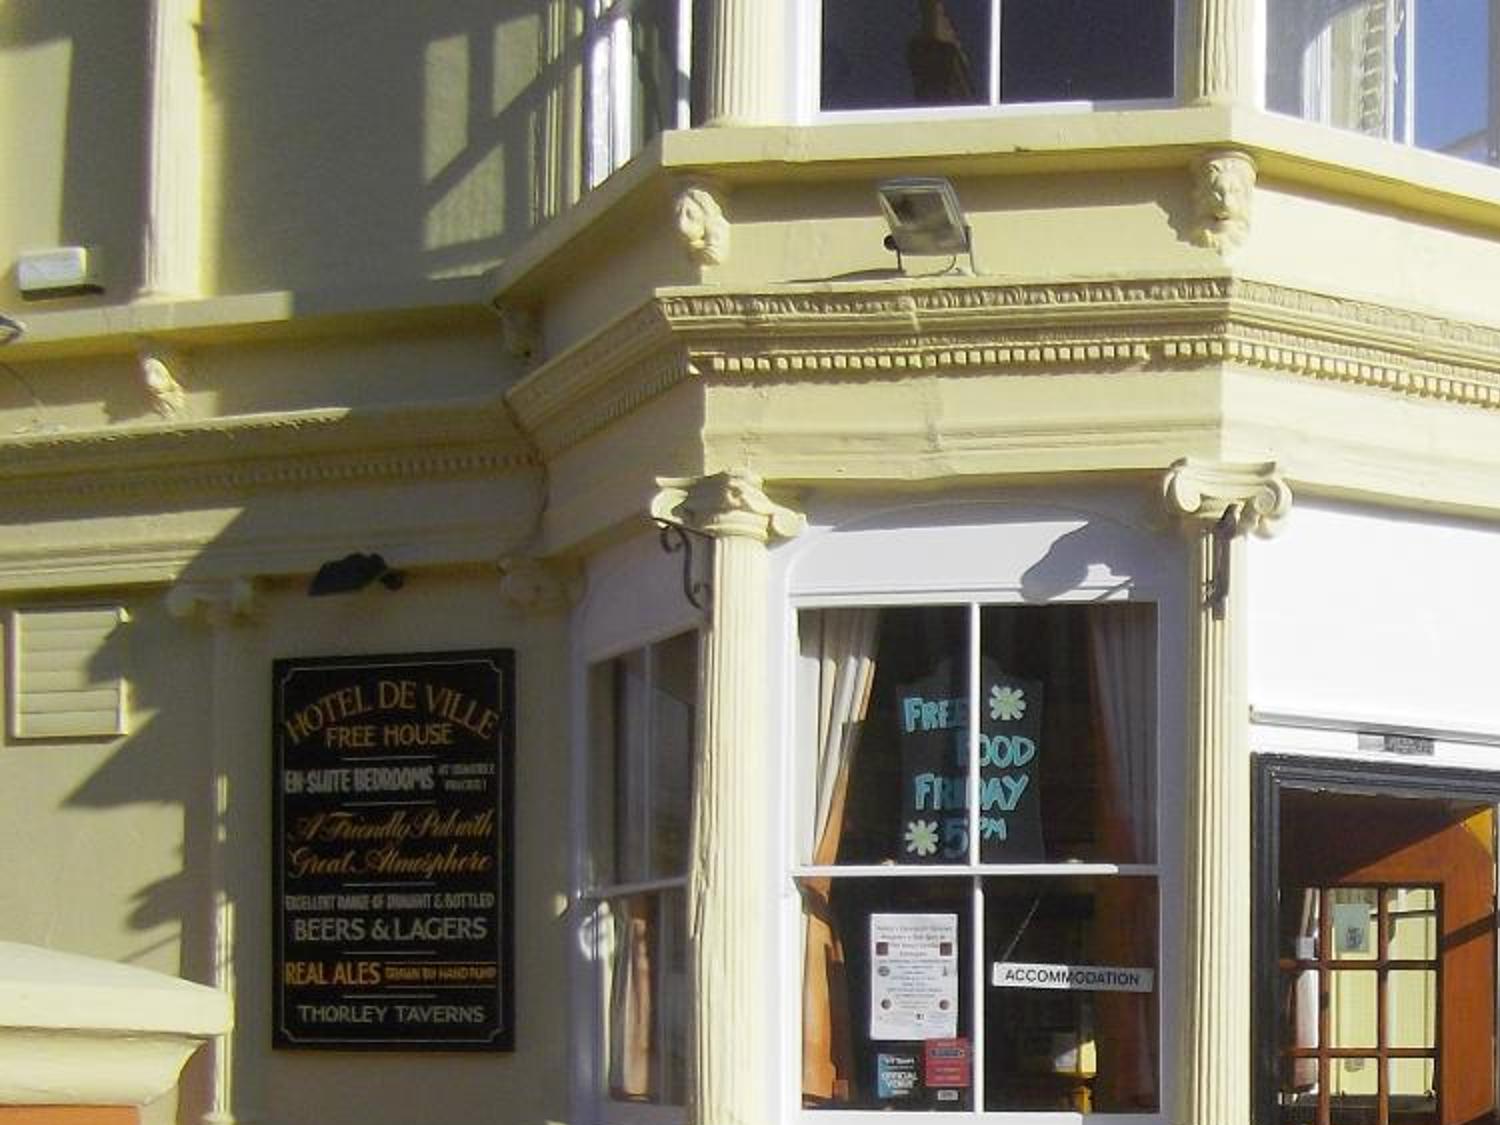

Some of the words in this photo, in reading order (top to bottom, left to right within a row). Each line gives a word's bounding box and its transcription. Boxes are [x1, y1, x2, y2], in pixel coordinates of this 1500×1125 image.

[285, 685, 373, 745] HOTEL
[377, 679, 417, 710] DE
[424, 682, 500, 741] VILLE
[324, 724, 378, 748] FREE
[383, 723, 455, 746] HOUSE
[353, 765, 435, 791] BEDROOMS
[288, 846, 361, 880] Great
[364, 844, 497, 879] Atmosphere
[294, 917, 366, 942] BEERS
[371, 918, 391, 941] &
[394, 916, 488, 940] LAGERS
[285, 961, 330, 987] REAL
[333, 960, 382, 985] ALES
[1005, 968, 1140, 987] ACCOMMODATION
[296, 1005, 388, 1024] THORLEY
[394, 1004, 487, 1023] TAVERNS
